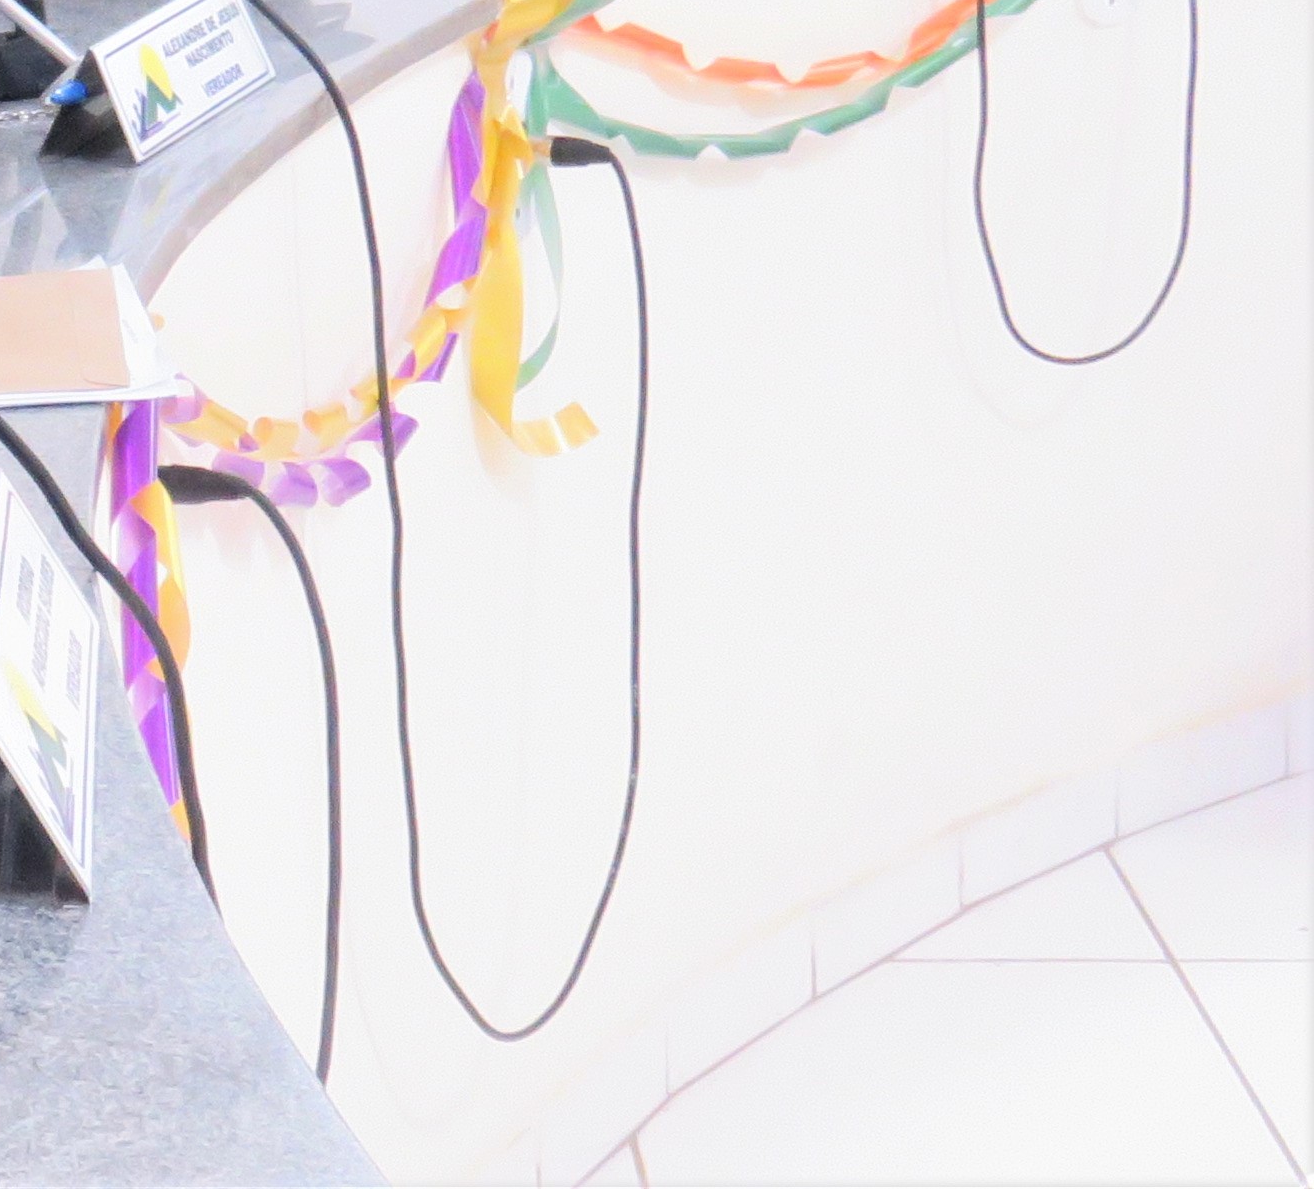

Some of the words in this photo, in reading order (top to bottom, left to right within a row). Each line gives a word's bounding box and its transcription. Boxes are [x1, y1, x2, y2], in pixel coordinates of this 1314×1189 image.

[162, 21, 207, 58] ALEXANDRE
[204, 15, 218, 33] DE
[184, 29, 235, 68] NASCIMENTO
[201, 63, 245, 98] VEREADOR
